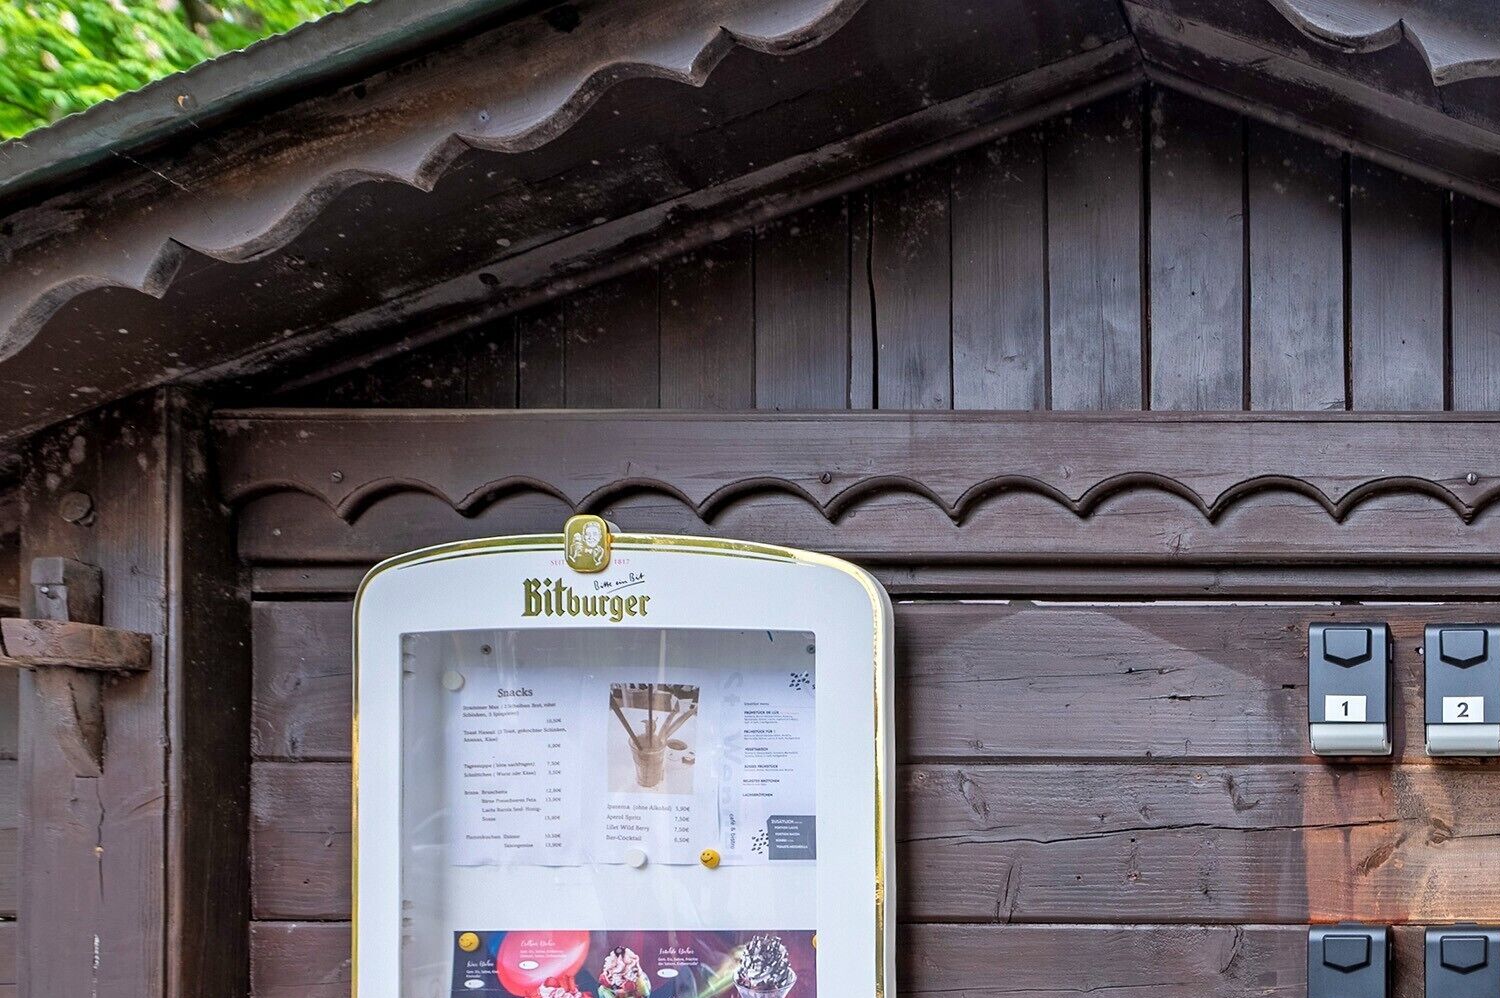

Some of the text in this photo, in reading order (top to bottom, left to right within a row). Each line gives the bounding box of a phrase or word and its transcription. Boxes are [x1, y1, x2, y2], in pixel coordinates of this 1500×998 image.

[594, 580, 612, 591] Bitte
[629, 572, 645, 582] Bit
[521, 577, 651, 623] Bitburger
[497, 688, 533, 698] Snacks
[1342, 701, 1349, 717] 1
[1458, 702, 1469, 718] 2
